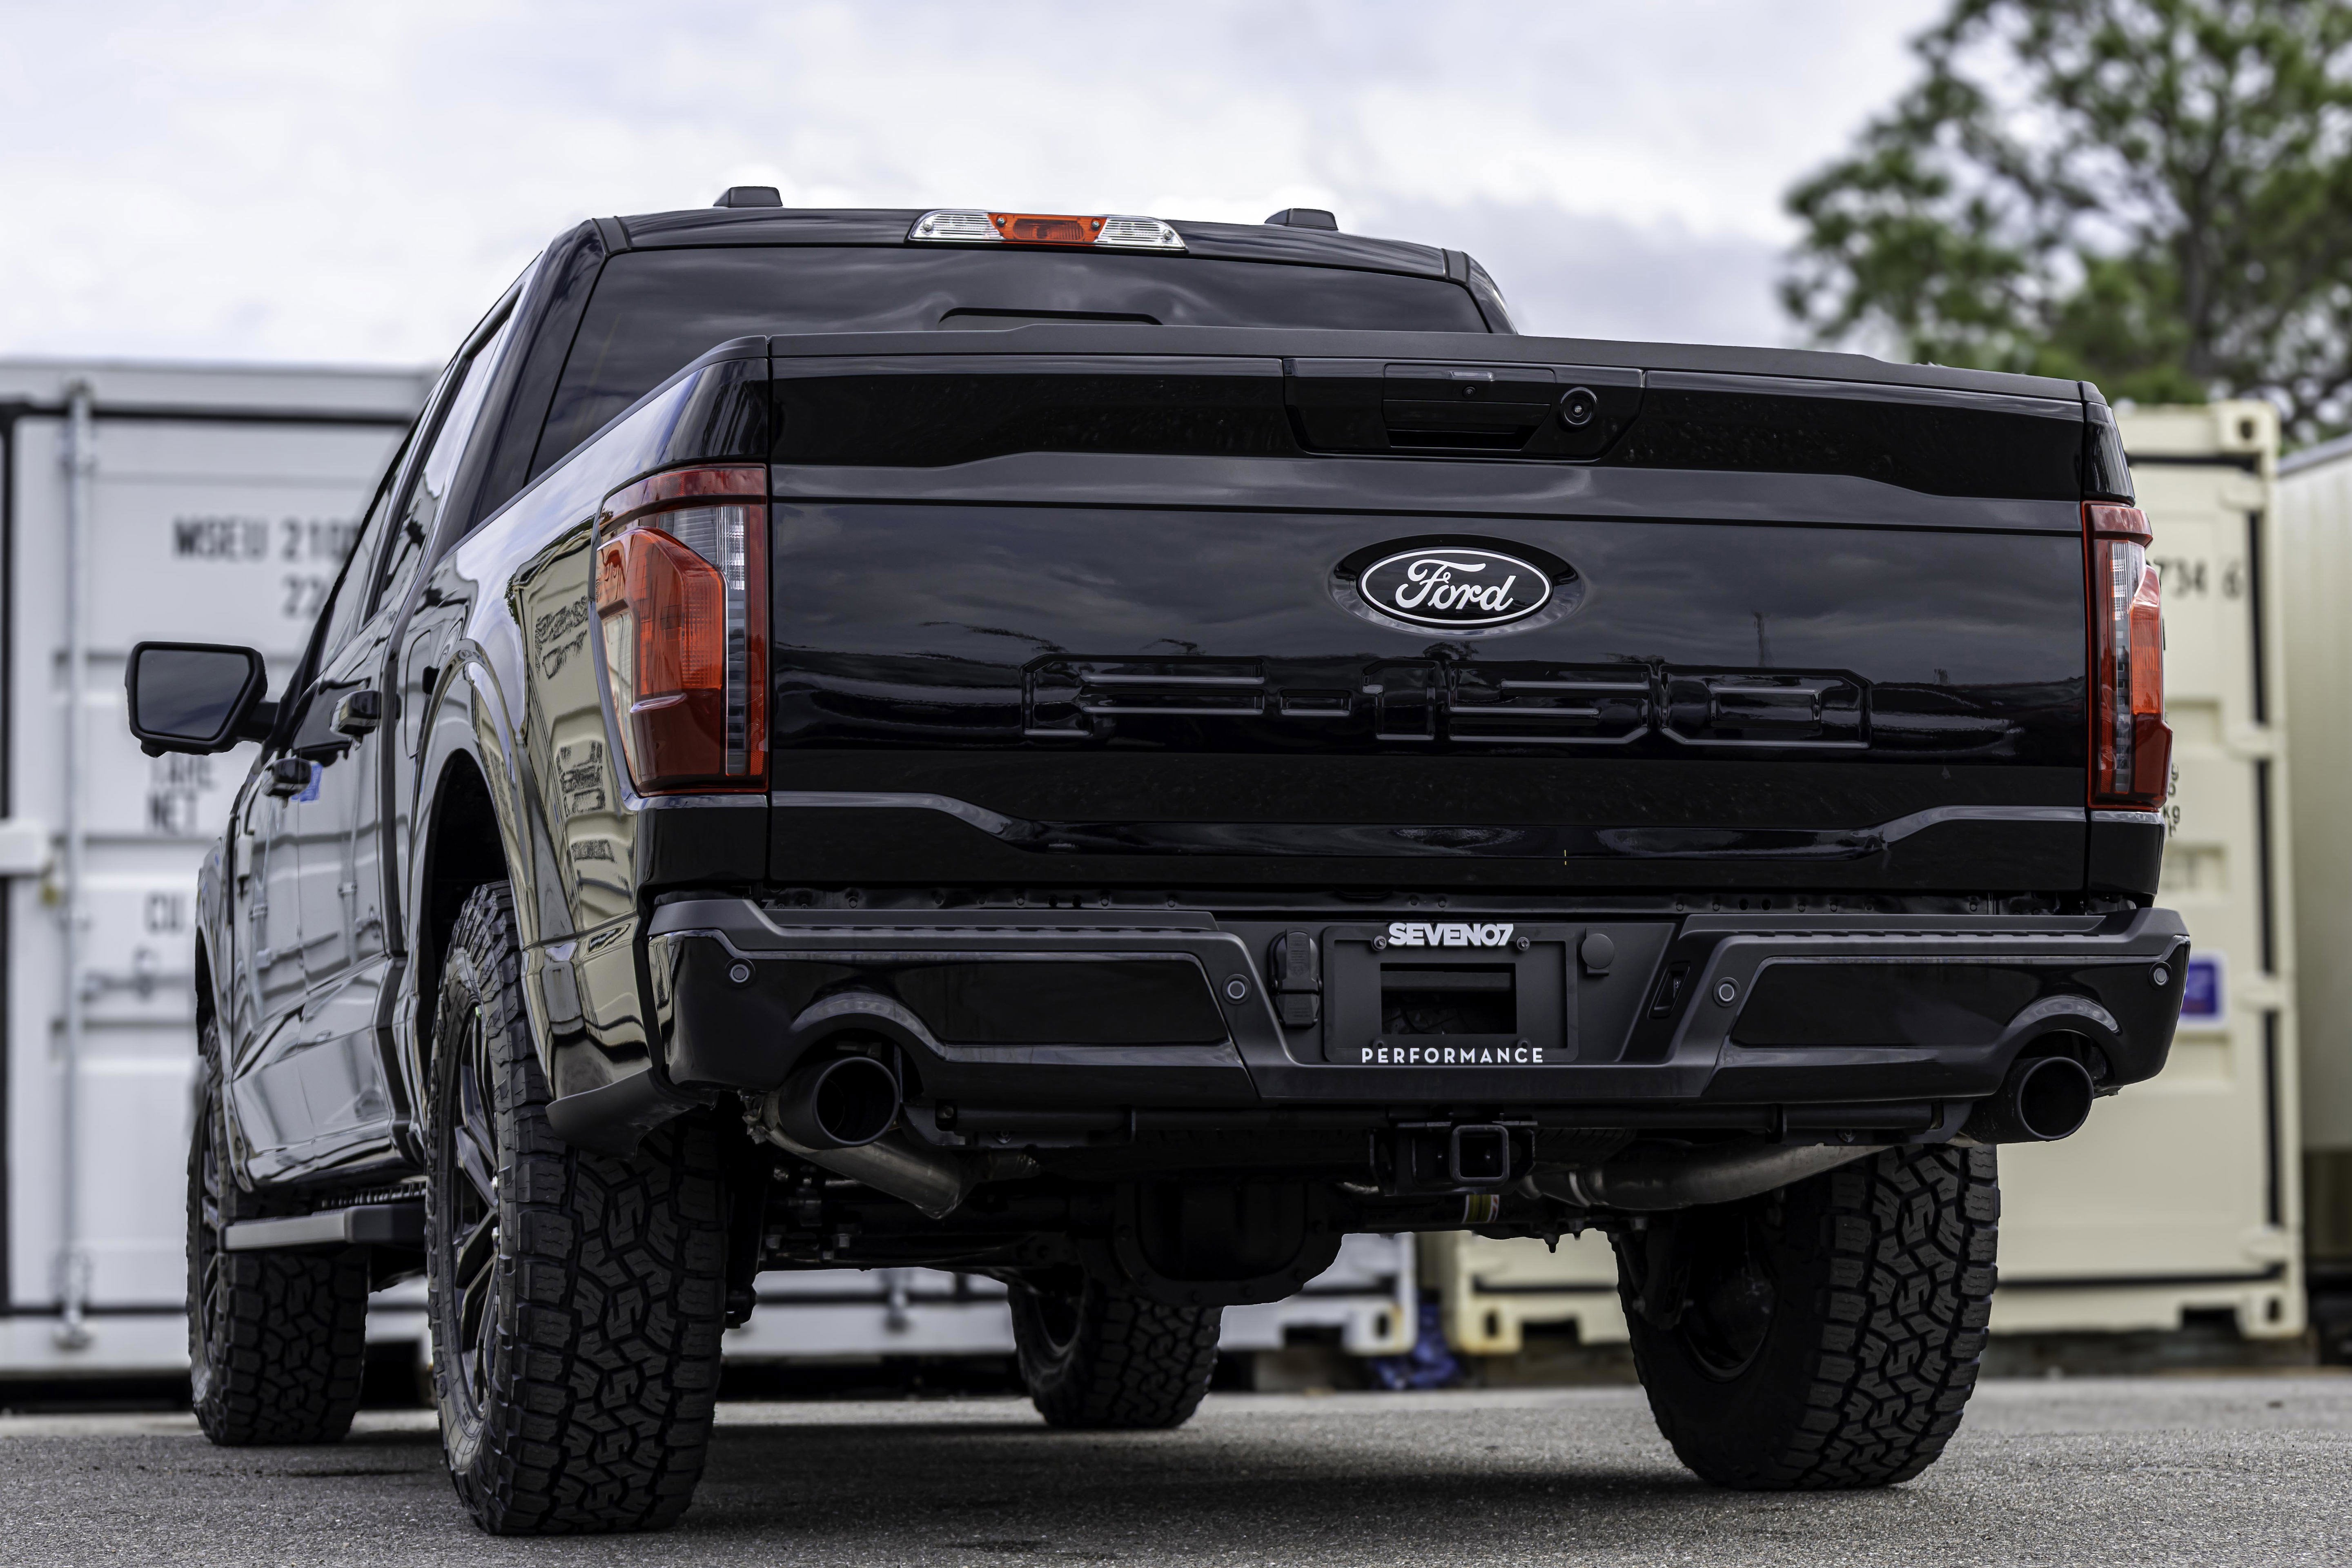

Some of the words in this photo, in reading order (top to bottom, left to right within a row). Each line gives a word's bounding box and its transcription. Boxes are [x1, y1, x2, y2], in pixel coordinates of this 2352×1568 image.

[1395, 559, 1514, 611] Ford
[1020, 653, 1872, 748] F-150
[1362, 1047, 1543, 1063] PERFORMANCE
